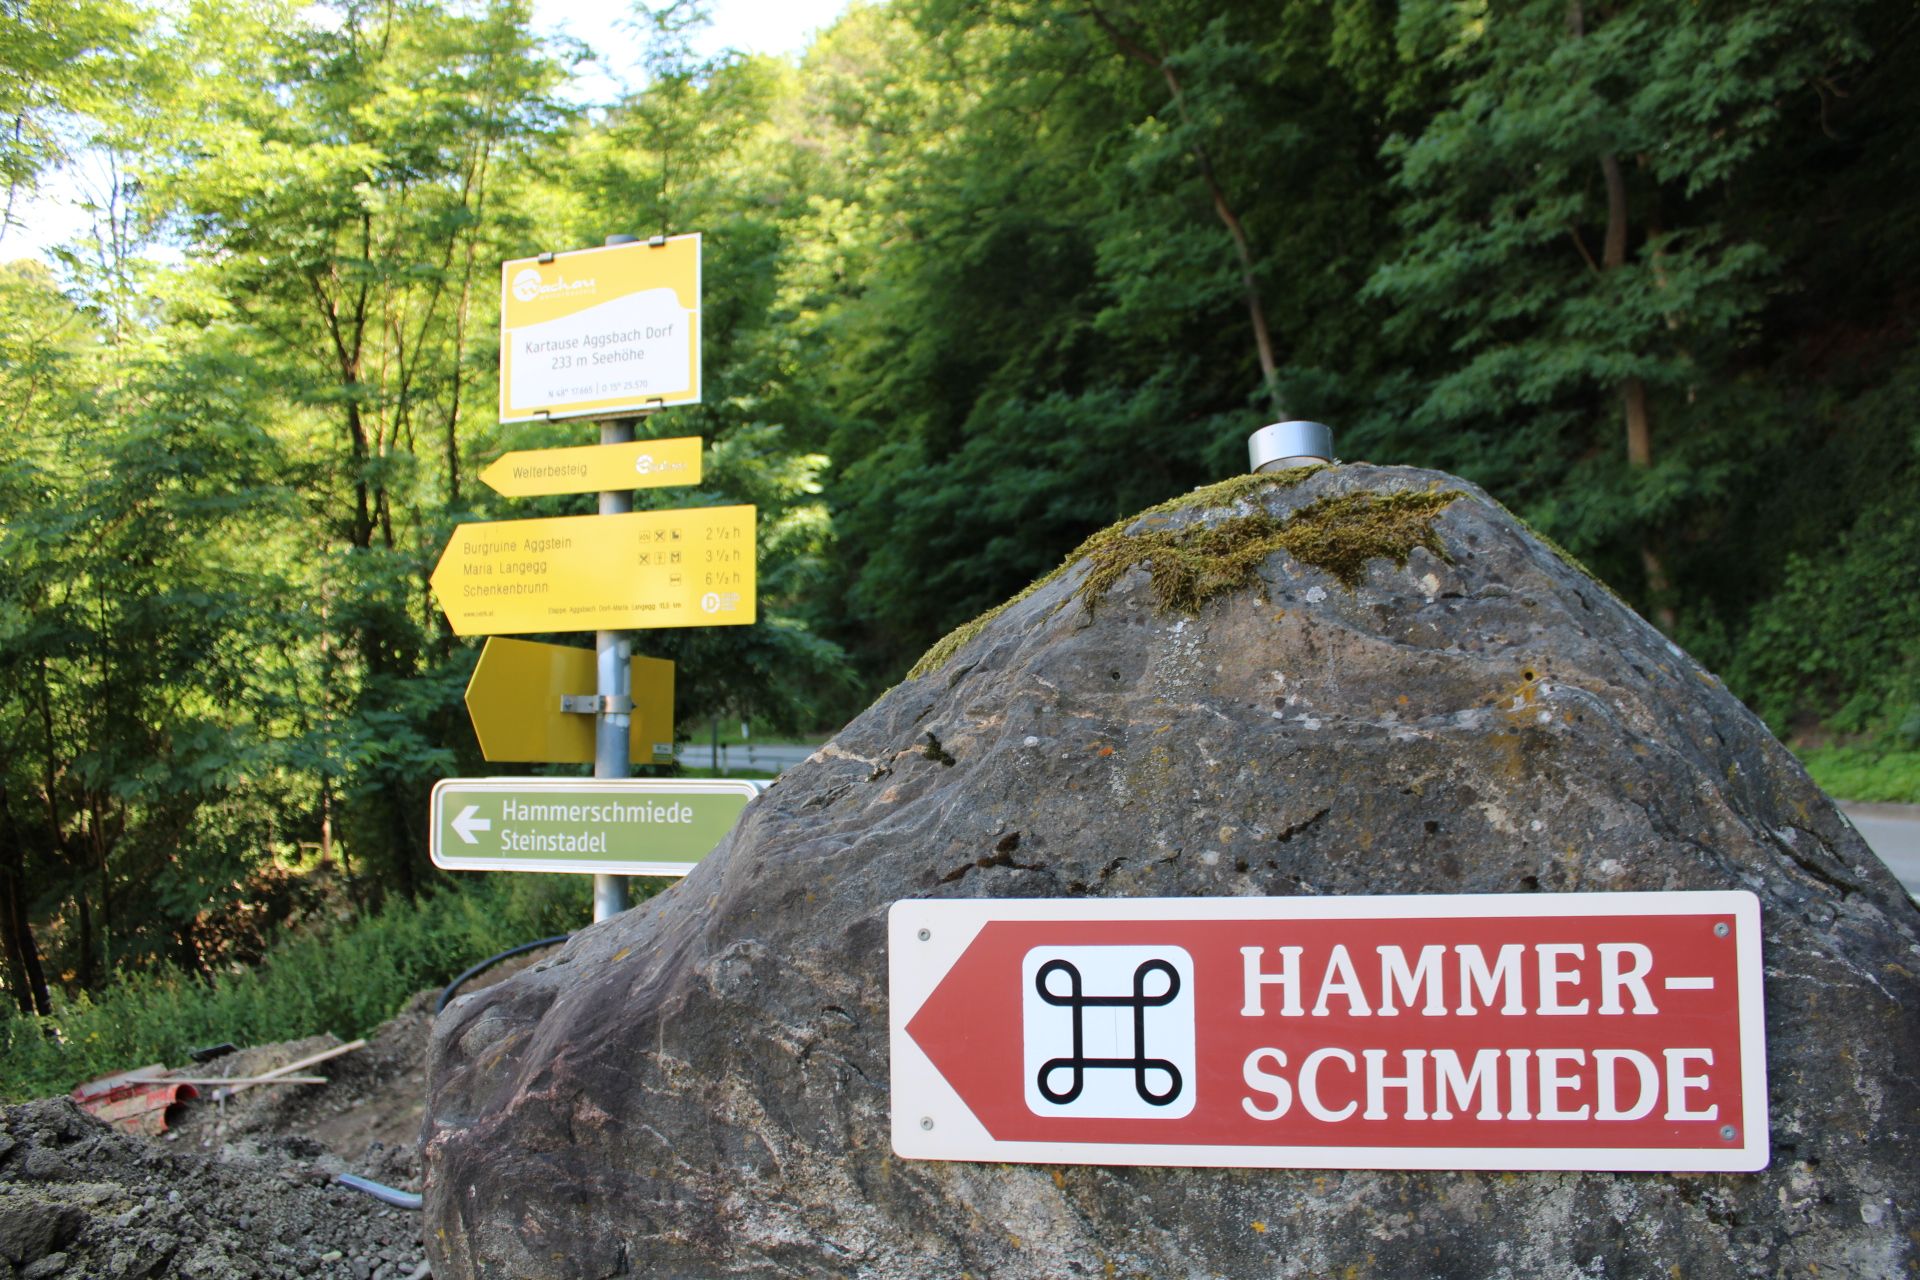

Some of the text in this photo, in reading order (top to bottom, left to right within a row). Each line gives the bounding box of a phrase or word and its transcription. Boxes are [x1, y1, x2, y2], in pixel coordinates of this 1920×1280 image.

[525, 323, 674, 354] Kartause Aggsbach Dorf
[551, 349, 645, 370] 233 m Seehöhe
[512, 463, 588, 479] Welterbesteig
[706, 527, 713, 540] 2
[733, 526, 740, 539] h
[463, 537, 572, 556] Burgruine Aggstein
[706, 550, 713, 562] 3
[733, 549, 740, 561] h
[463, 560, 547, 576] Maria Langegg
[706, 572, 713, 585] 6
[733, 572, 740, 584] h
[463, 582, 548, 598] Schenkenbrunn
[502, 798, 693, 824] Hammerschmiede
[500, 829, 607, 853] Steinstadel
[1240, 942, 1715, 1017] HAMMER-
[1241, 1047, 1719, 1123] SCHMIEDE
